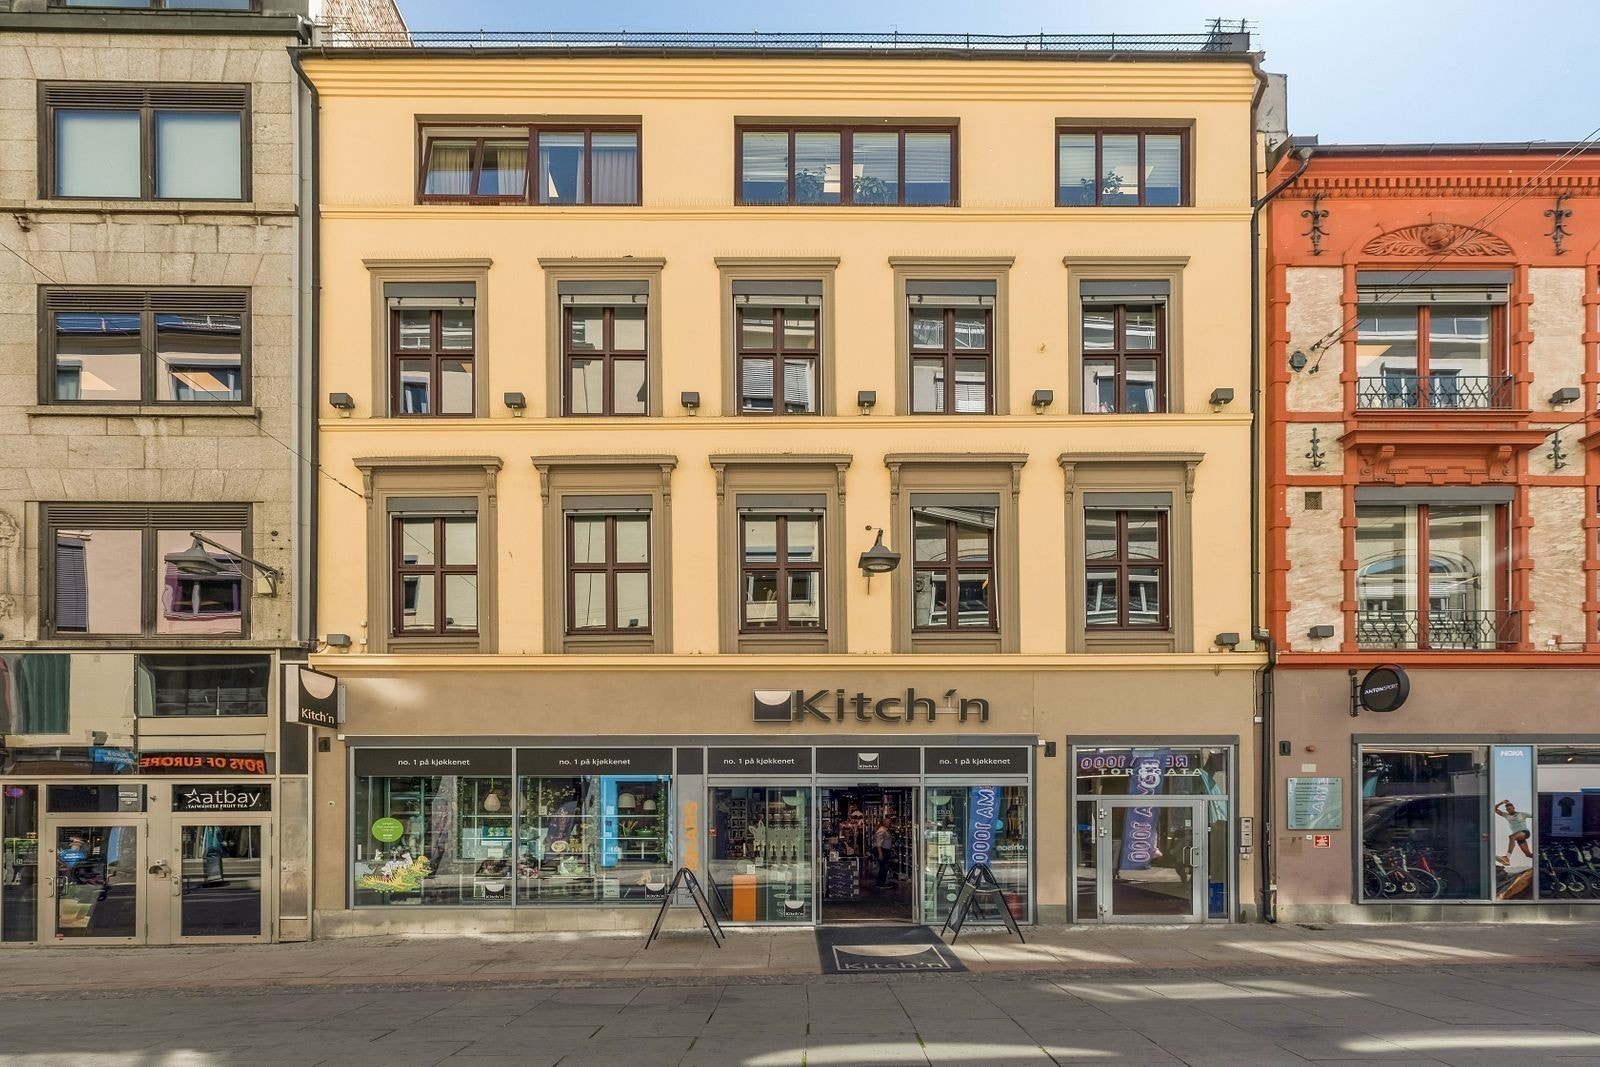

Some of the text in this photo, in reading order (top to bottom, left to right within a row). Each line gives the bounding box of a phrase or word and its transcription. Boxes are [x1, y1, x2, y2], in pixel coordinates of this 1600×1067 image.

[795, 687, 990, 722] Kitch'n
[419, 758, 430, 767] på
[431, 758, 470, 767] kjøkkenet
[580, 758, 591, 766] på
[592, 758, 631, 767] kjøkkenet
[744, 757, 755, 766] på
[756, 757, 795, 766] kjøkkenet
[960, 757, 971, 766] på
[972, 757, 1011, 766] kjøkkenet
